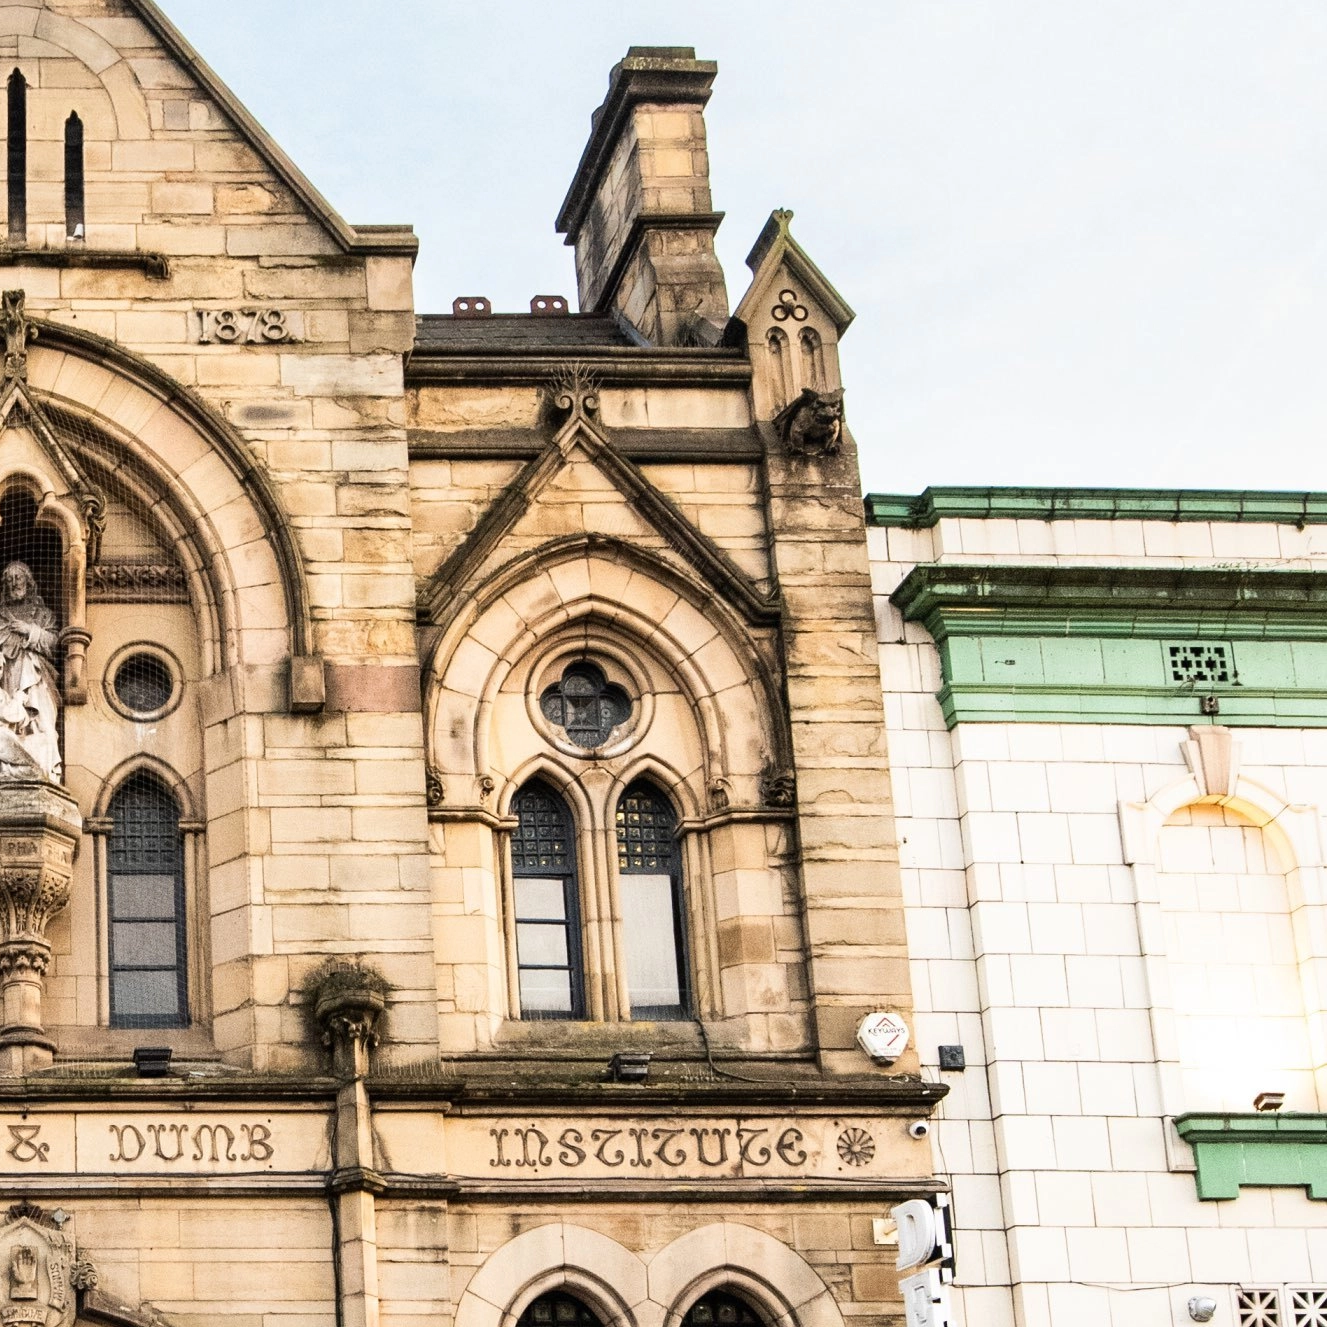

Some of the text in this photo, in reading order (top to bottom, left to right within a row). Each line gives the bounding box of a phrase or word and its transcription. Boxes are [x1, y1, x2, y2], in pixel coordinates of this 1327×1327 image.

[5, 1125, 50, 1162] &
[109, 1124, 274, 1162] DUMB
[489, 1127, 808, 1168] INSTITUTE
